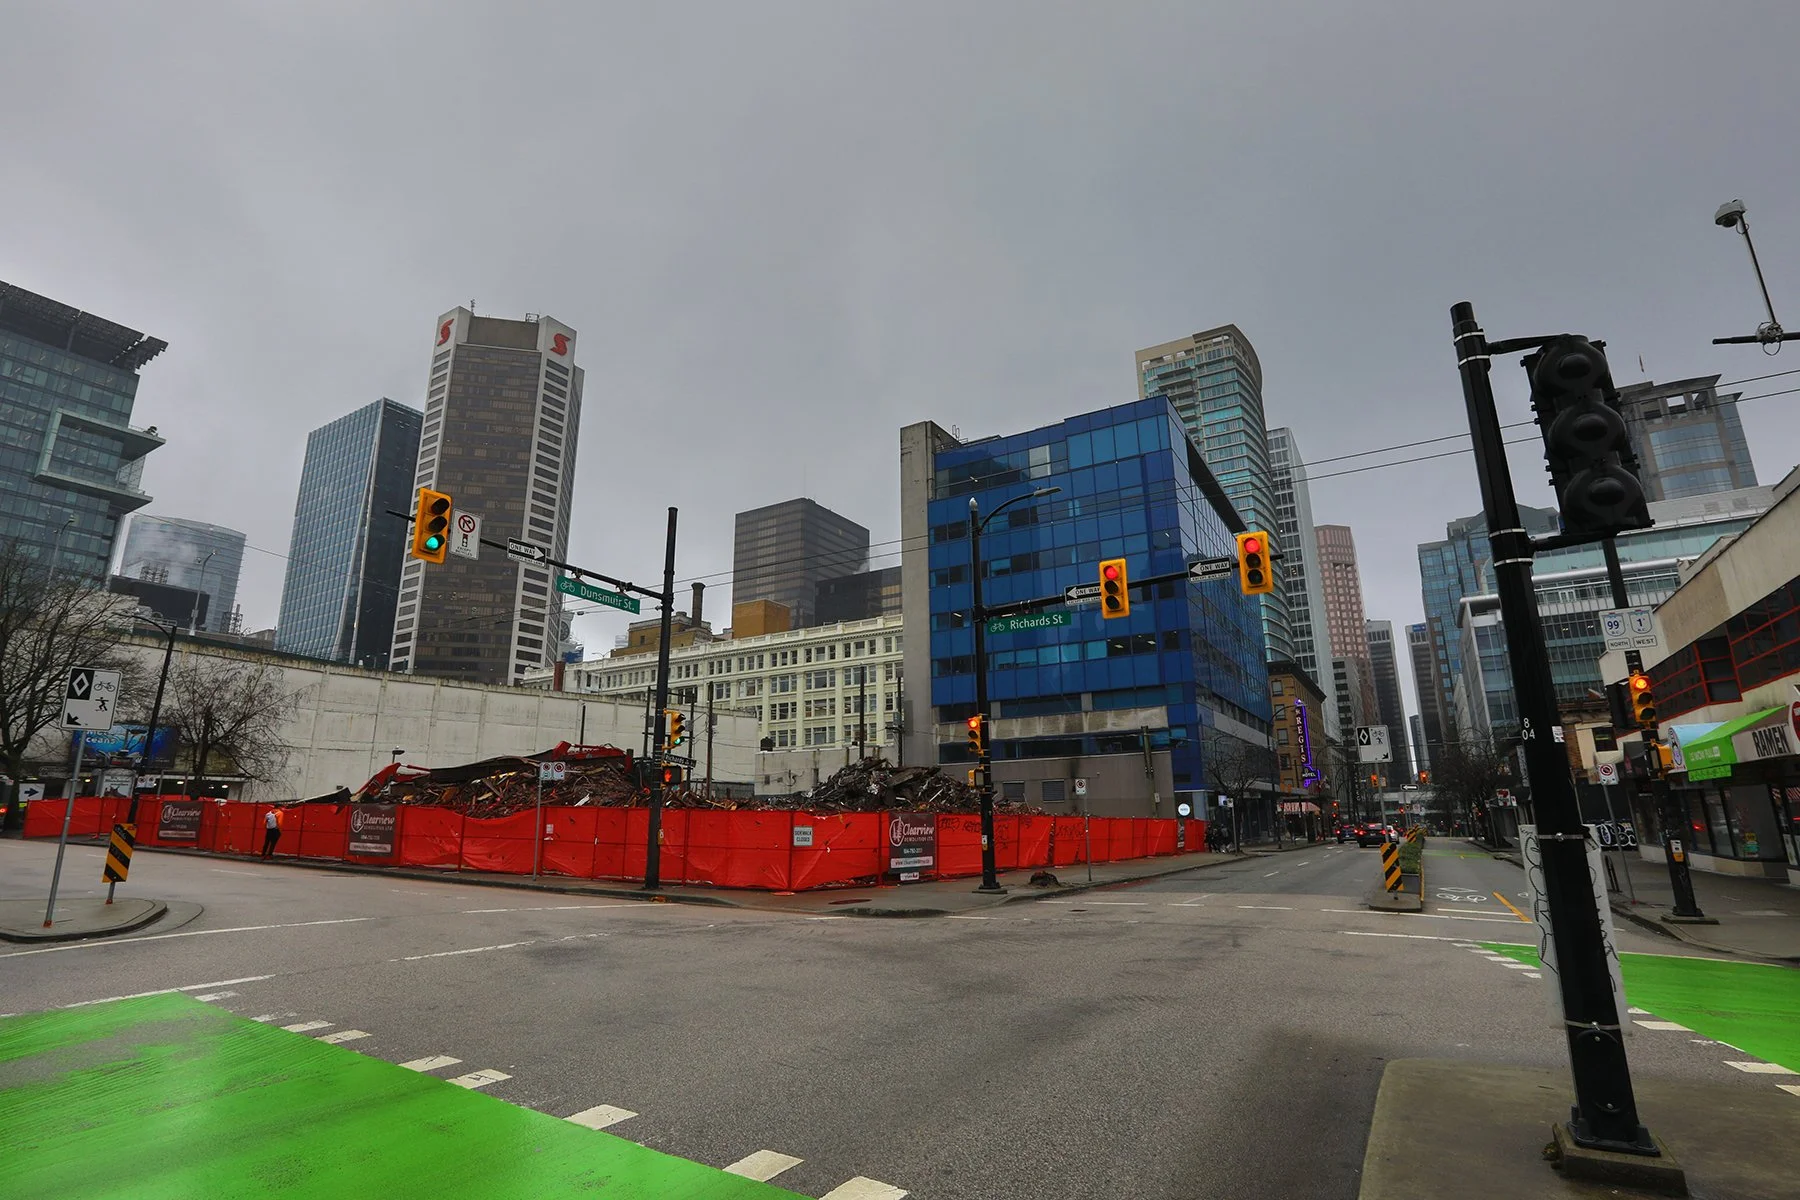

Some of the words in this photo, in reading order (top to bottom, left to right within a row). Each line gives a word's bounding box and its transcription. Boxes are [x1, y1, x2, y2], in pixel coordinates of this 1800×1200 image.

[510, 543, 522, 551] ONE
[524, 547, 536, 555] WAY
[581, 586, 622, 606] Dunsmuir
[623, 599, 635, 611] St.
[1010, 616, 1050, 630] Richards
[1052, 614, 1063, 625] St
[1607, 620, 1619, 630] 99
[1637, 618, 1643, 627] 1
[1523, 717, 1530, 728] 8
[1296, 717, 1307, 762] REGIS
[1522, 728, 1535, 740] 04
[80, 737, 116, 745] ceans
[1752, 725, 1791, 758] RAMEN
[363, 813, 395, 825] Clearview
[903, 823, 935, 836] Clearview
